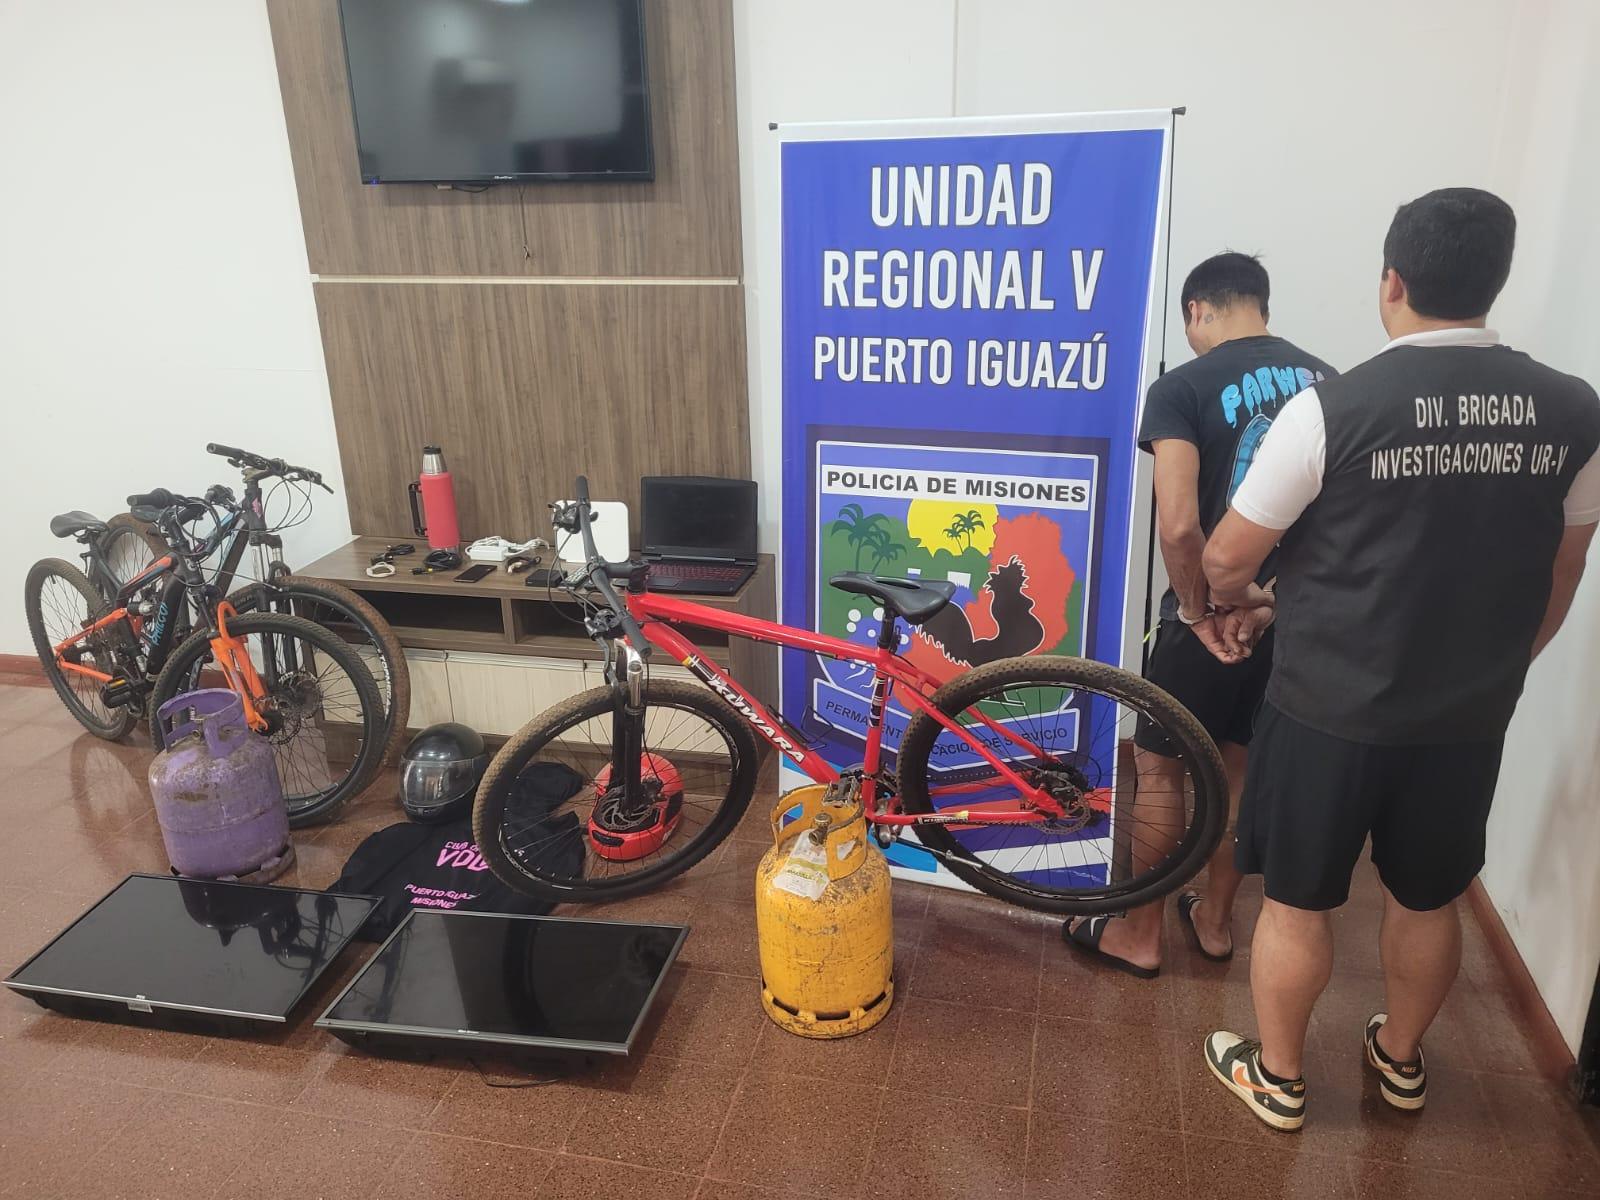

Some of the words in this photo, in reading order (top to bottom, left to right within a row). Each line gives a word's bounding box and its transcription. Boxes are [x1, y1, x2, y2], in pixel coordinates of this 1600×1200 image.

[871, 162, 1053, 227] UNIDAD
[823, 249, 1055, 310] REGIONAL
[1071, 249, 1104, 311] V
[814, 336, 953, 385] PUERTO
[967, 333, 1108, 391] IGUAZÚ
[1415, 396, 1449, 428] DIV.
[1458, 394, 1537, 426] BRIGADA
[1371, 442, 1523, 480] INVESTIGACIONES
[1530, 444, 1569, 476] UR-V
[827, 471, 919, 492] POLICIA
[927, 477, 957, 495] DE
[965, 479, 1086, 503] MISIONES
[706, 675, 805, 763] KUWARA
[1004, 727, 1067, 746] SRVICIO
